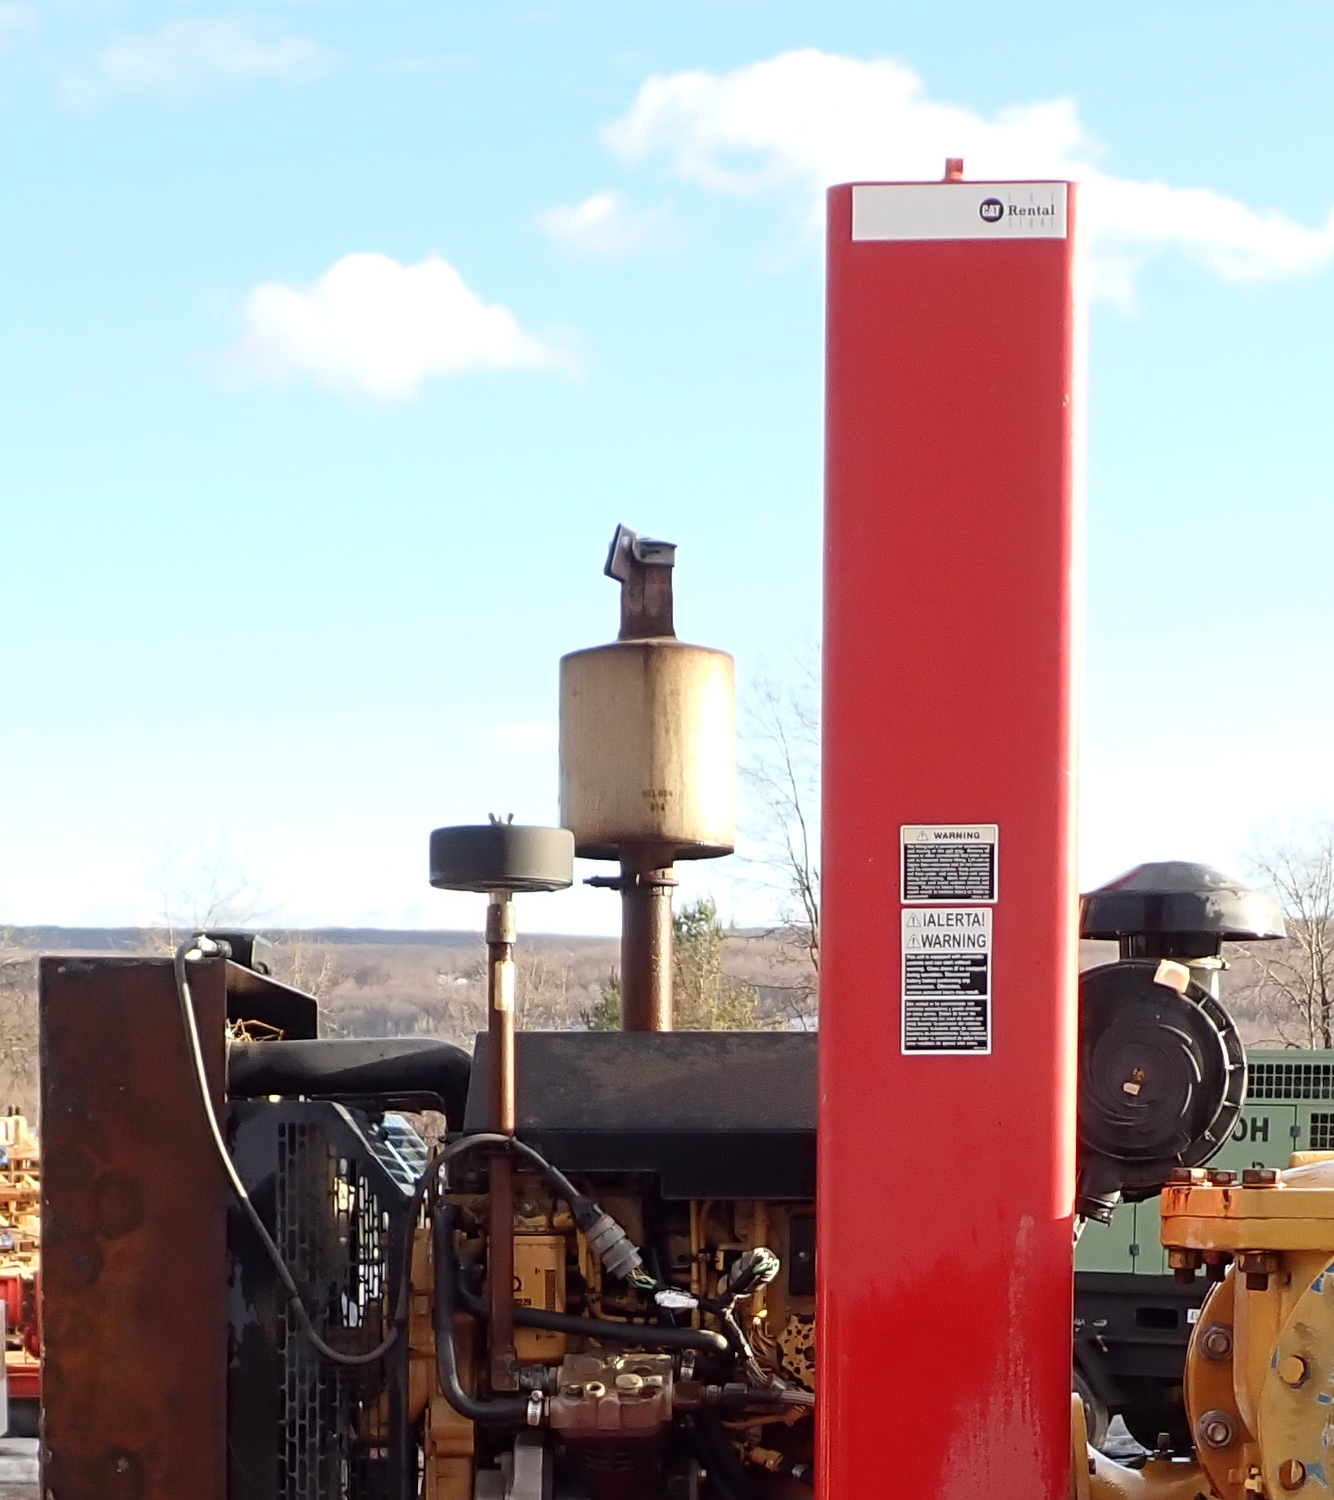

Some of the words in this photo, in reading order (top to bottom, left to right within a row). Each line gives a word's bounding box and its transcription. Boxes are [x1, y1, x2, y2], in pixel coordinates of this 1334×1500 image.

[982, 204, 1001, 217] CAT
[1008, 204, 1055, 216] Rental
[933, 831, 981, 840] WARNING
[920, 933, 987, 948] WARNING
